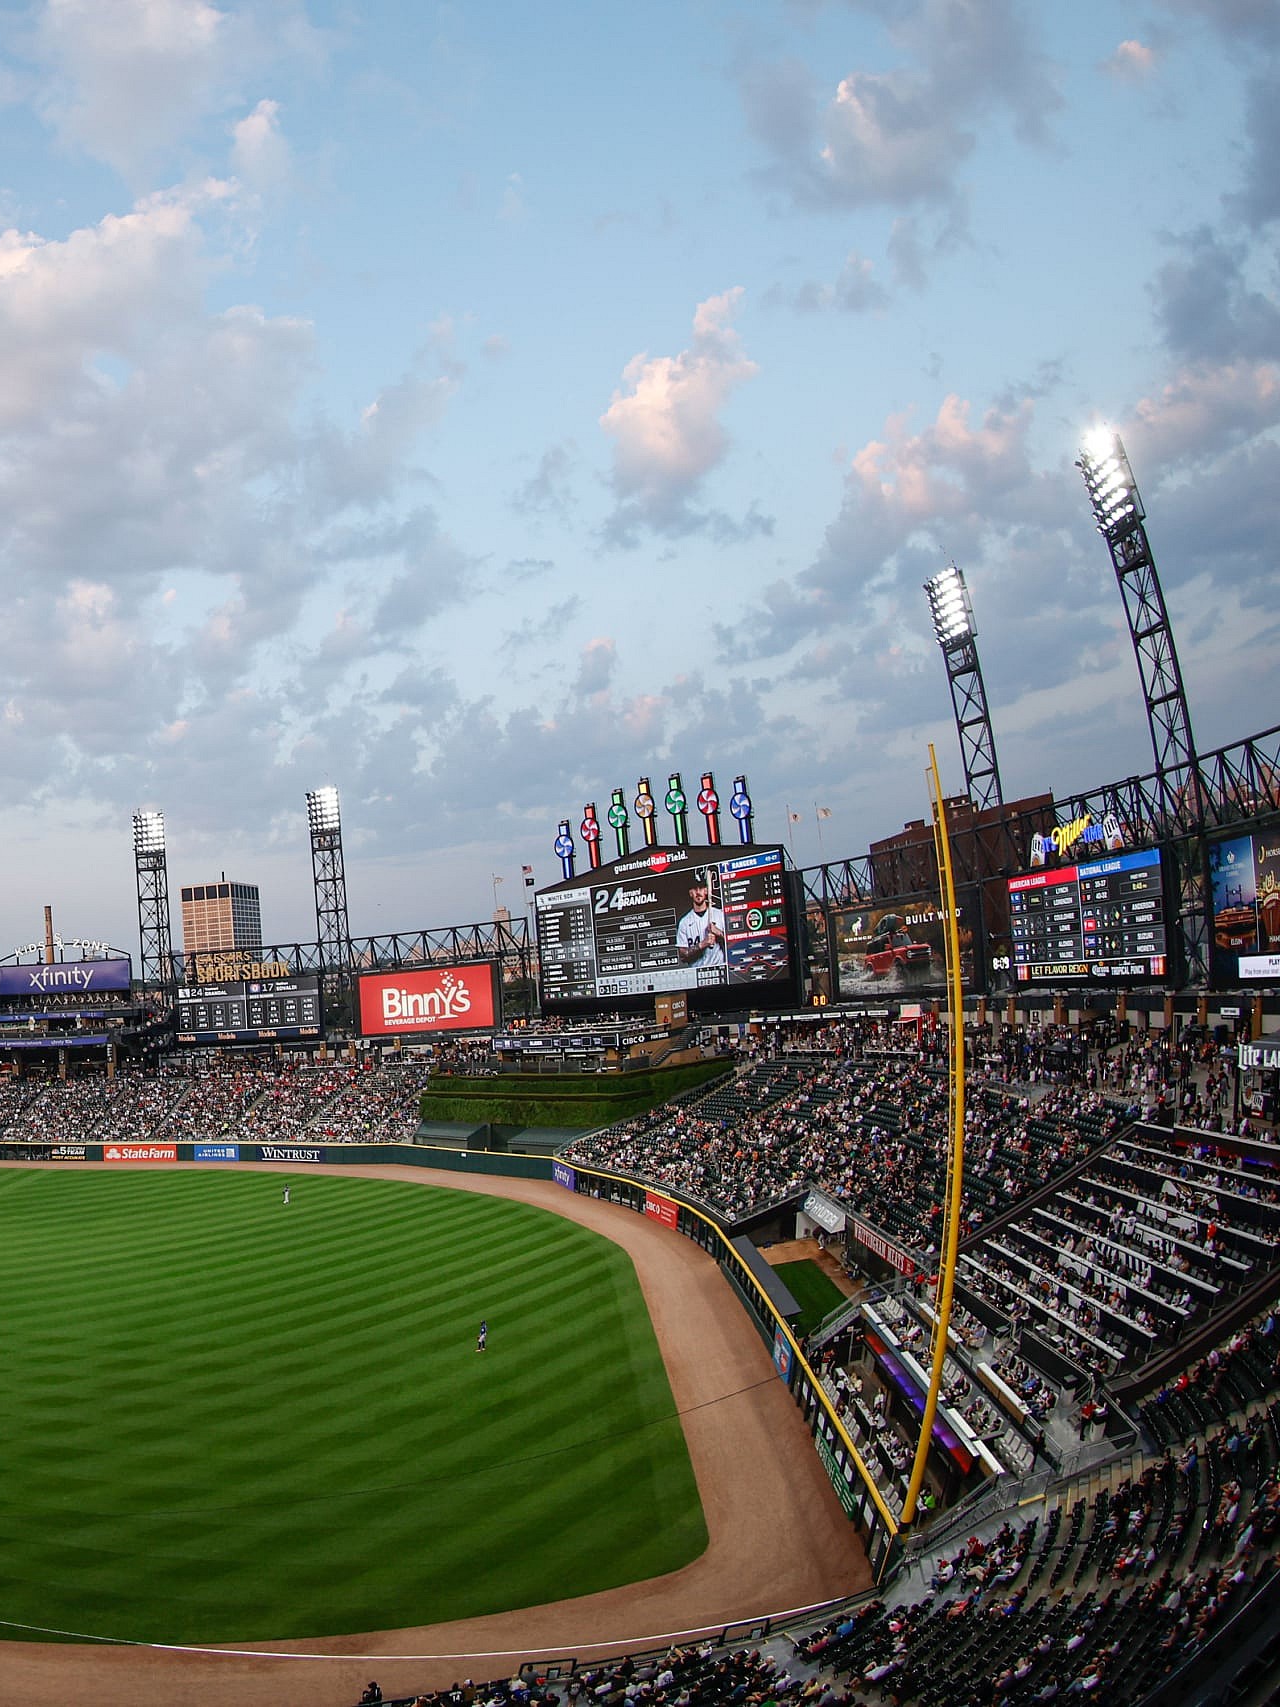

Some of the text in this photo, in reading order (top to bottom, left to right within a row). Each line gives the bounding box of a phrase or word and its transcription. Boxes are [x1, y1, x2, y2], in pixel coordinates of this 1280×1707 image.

[1051, 812, 1092, 856] Miller
[732, 858, 757, 869] RANGERS
[1103, 861, 1120, 872] LEAGUE
[595, 887, 623, 914] 24
[906, 909, 961, 925] BUILT WID
[15, 941, 45, 958] KIDS
[73, 938, 110, 952] ZONE
[196, 951, 250, 964] CAESARS
[993, 956, 1010, 970] 8:09
[197, 961, 290, 983] SPORTSBOOK
[1032, 964, 1088, 975] LET FLAVOR REIGN
[1111, 966, 1130, 975] TROPICAL
[1131, 965, 1144, 974] PUNCH
[29, 966, 94, 991] xfinity
[262, 983, 273, 992] 17
[384, 1018, 415, 1026] BEVERAGE
[60, 1147, 66, 1155] 5
[262, 1147, 319, 1159] WINTRUST
[554, 1164, 570, 1185] xfinity
